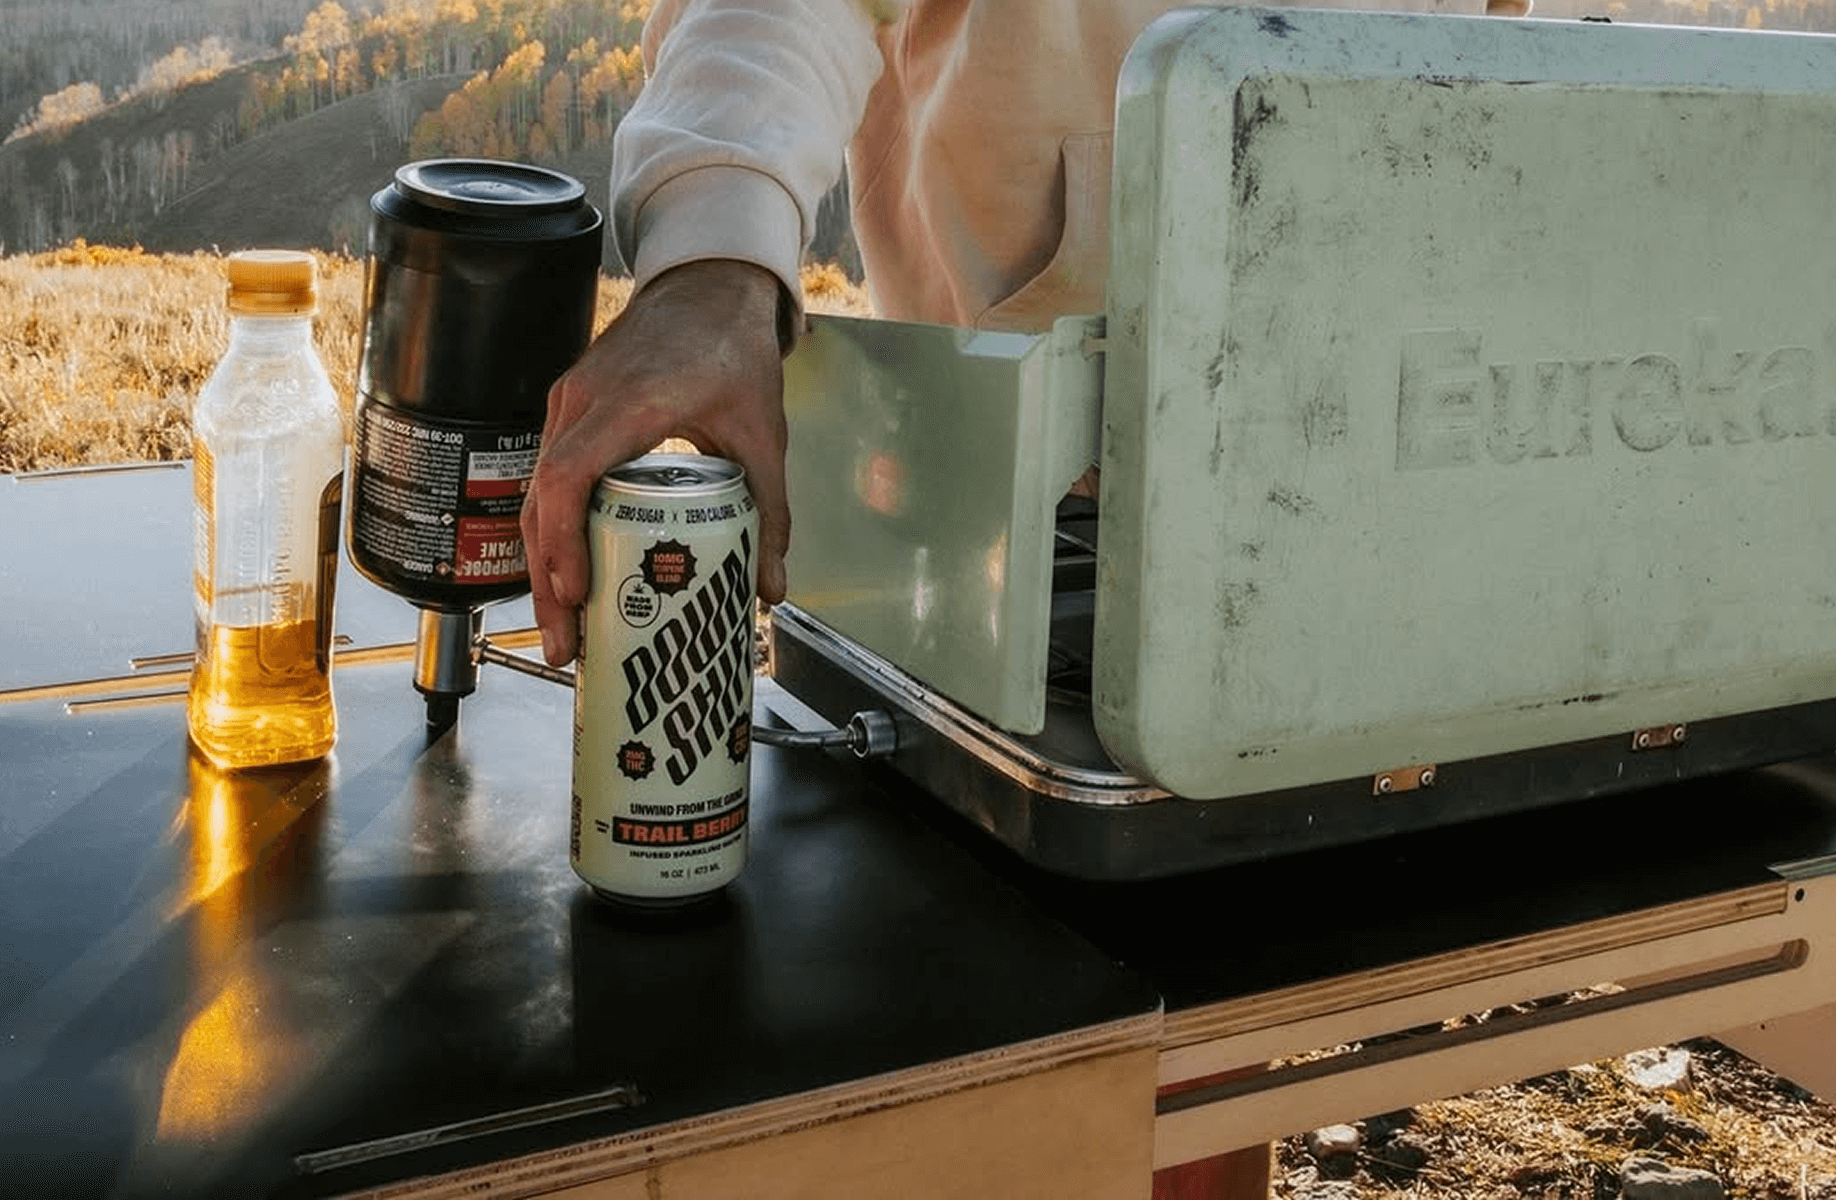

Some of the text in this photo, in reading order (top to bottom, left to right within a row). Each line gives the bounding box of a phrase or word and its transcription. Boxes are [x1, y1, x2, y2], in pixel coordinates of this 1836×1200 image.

[616, 504, 635, 521] ZERO
[637, 507, 665, 523] SUGAR
[685, 508, 708, 523] ZERO
[624, 602, 653, 612] FROM
[621, 526, 751, 736] DOWN
[625, 760, 646, 772] THC
[630, 803, 674, 816] UNWIND
[676, 800, 705, 816] FROM
[706, 796, 723, 811] THE
[620, 823, 690, 843] TRAIL
[629, 850, 672, 860] INFUSED
[673, 844, 722, 859] SPARKLING
[671, 869, 684, 879] OZ
